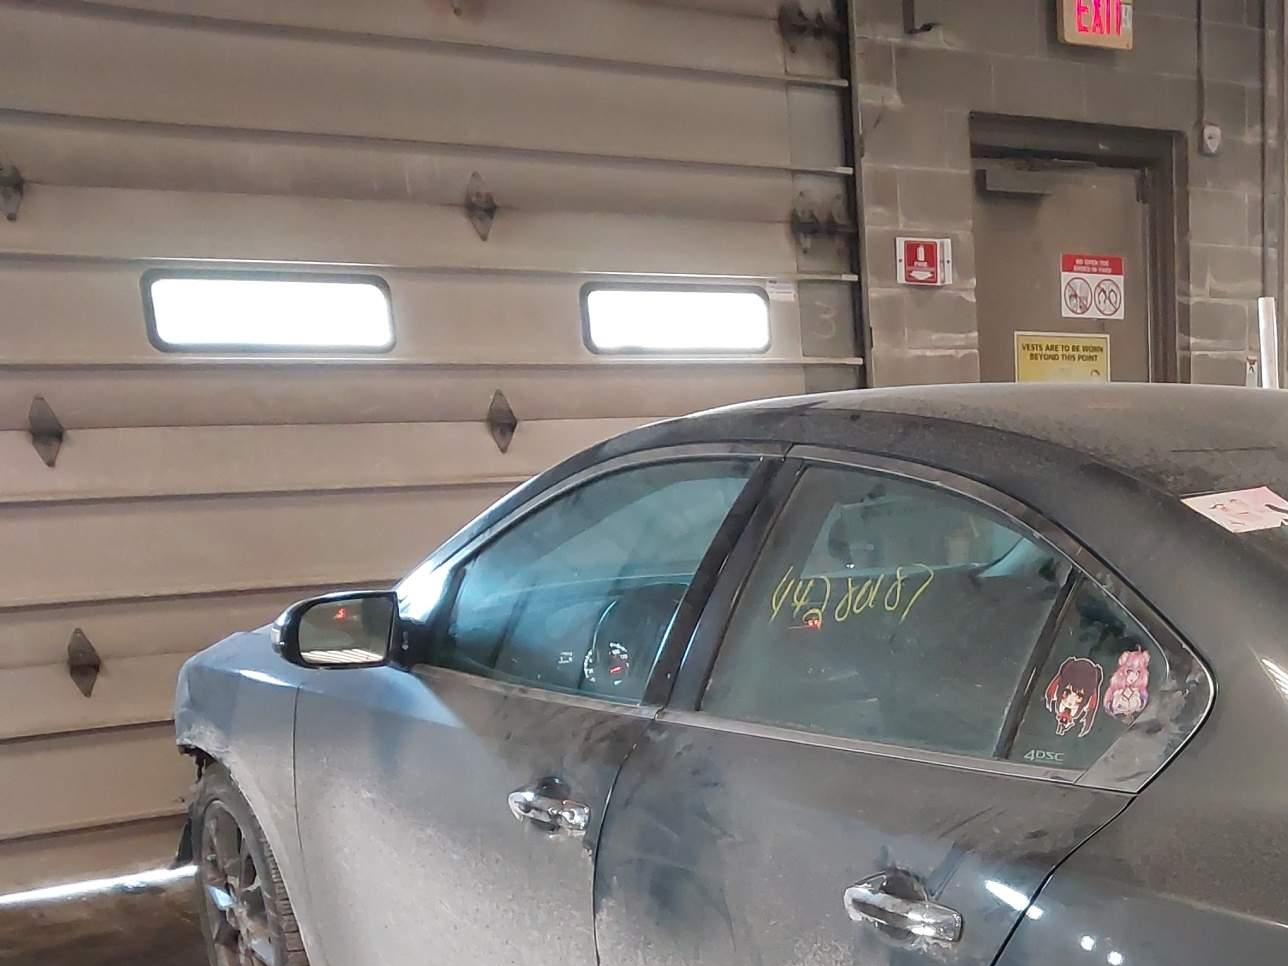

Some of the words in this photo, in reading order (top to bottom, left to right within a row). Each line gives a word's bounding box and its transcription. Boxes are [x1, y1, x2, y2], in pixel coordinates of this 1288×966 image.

[1022, 344, 1044, 352] VESTS
[1045, 344, 1059, 352] ARE
[1061, 344, 1070, 352] TO
[1081, 345, 1104, 353] WORN
[1029, 353, 1060, 361] BEYOND
[1061, 353, 1076, 362] THIS
[1023, 749, 1065, 762] 4DSC
